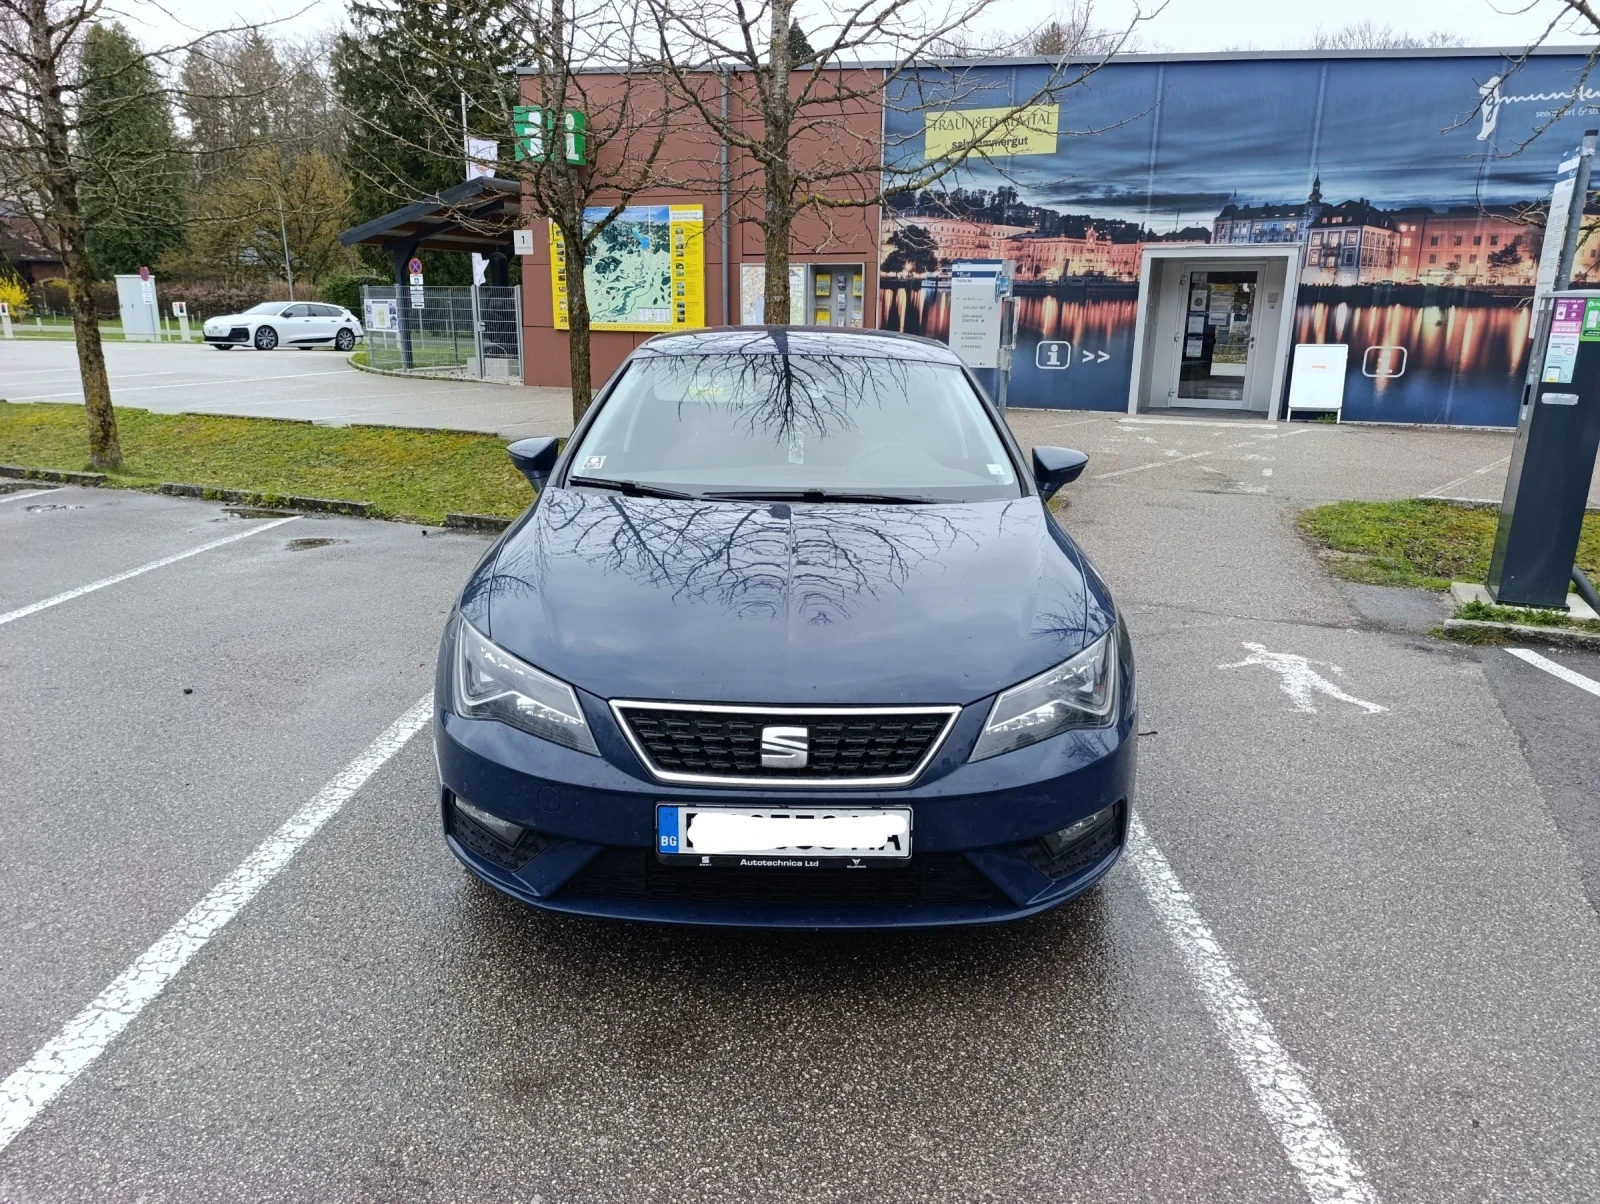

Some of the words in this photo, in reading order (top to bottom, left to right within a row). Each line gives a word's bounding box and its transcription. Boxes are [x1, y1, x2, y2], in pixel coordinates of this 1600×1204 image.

[521, 235, 525, 245] 1
[661, 836, 677, 846] BG
[740, 858, 803, 866] Autotechnica
